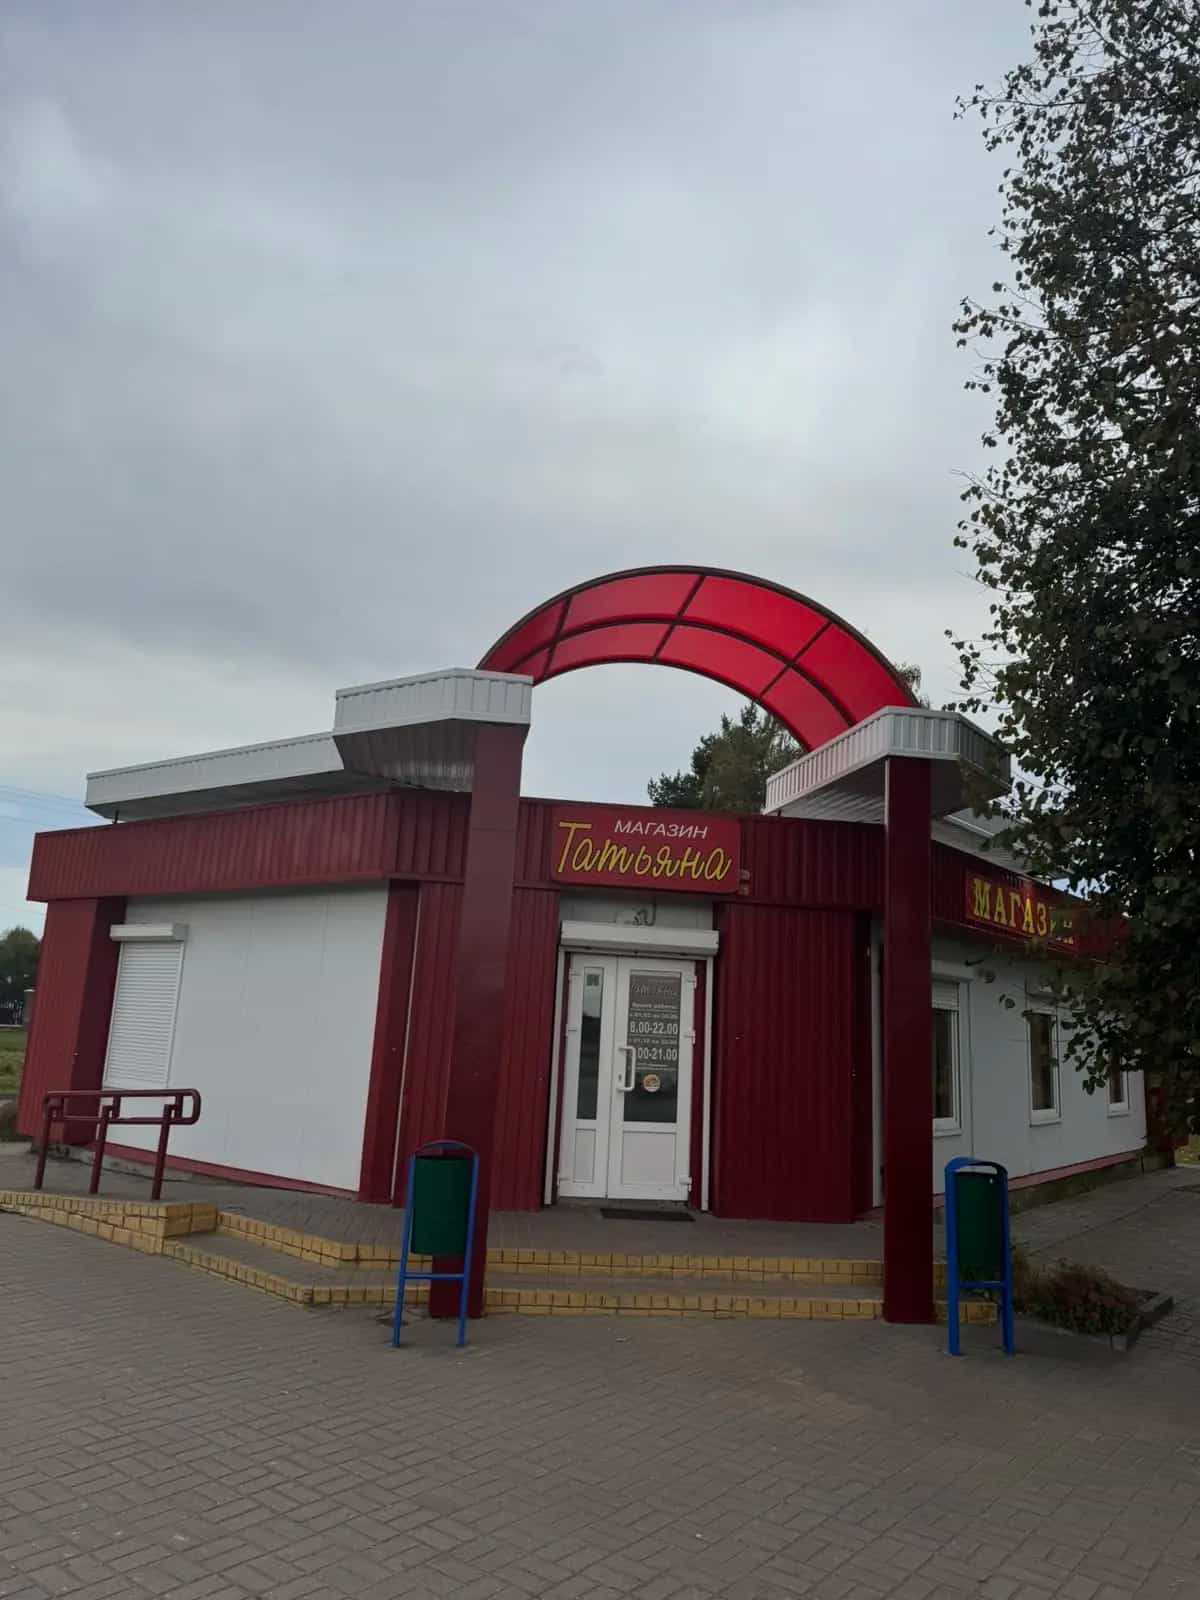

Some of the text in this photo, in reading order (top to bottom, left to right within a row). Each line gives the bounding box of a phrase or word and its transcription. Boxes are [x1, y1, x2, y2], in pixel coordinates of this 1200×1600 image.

[614, 820, 709, 840] МАГАЗИН
[558, 821, 732, 881] Татьяна
[974, 878, 1074, 945] МАГАЗ
[630, 1021, 678, 1035] 8.00-22.00
